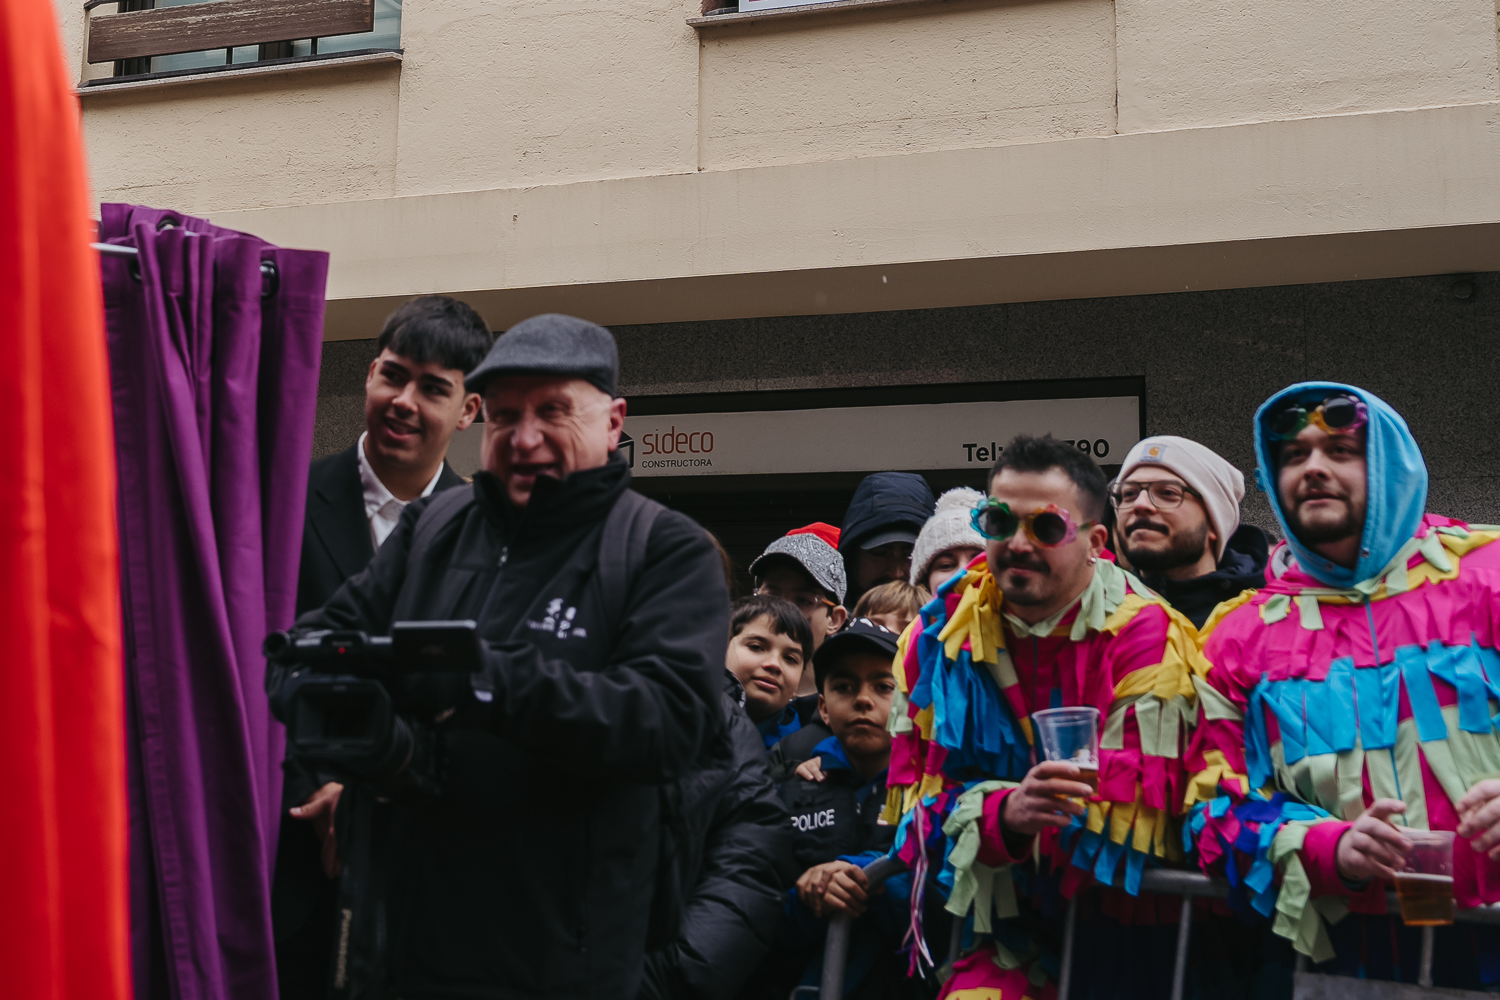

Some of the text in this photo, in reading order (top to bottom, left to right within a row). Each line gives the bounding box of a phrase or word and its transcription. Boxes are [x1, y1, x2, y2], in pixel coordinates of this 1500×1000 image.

[642, 425, 714, 455] sideco
[962, 441, 1004, 462] Tel:
[641, 458, 713, 469] CONSTRUCTORA
[790, 808, 835, 832] POLICE
